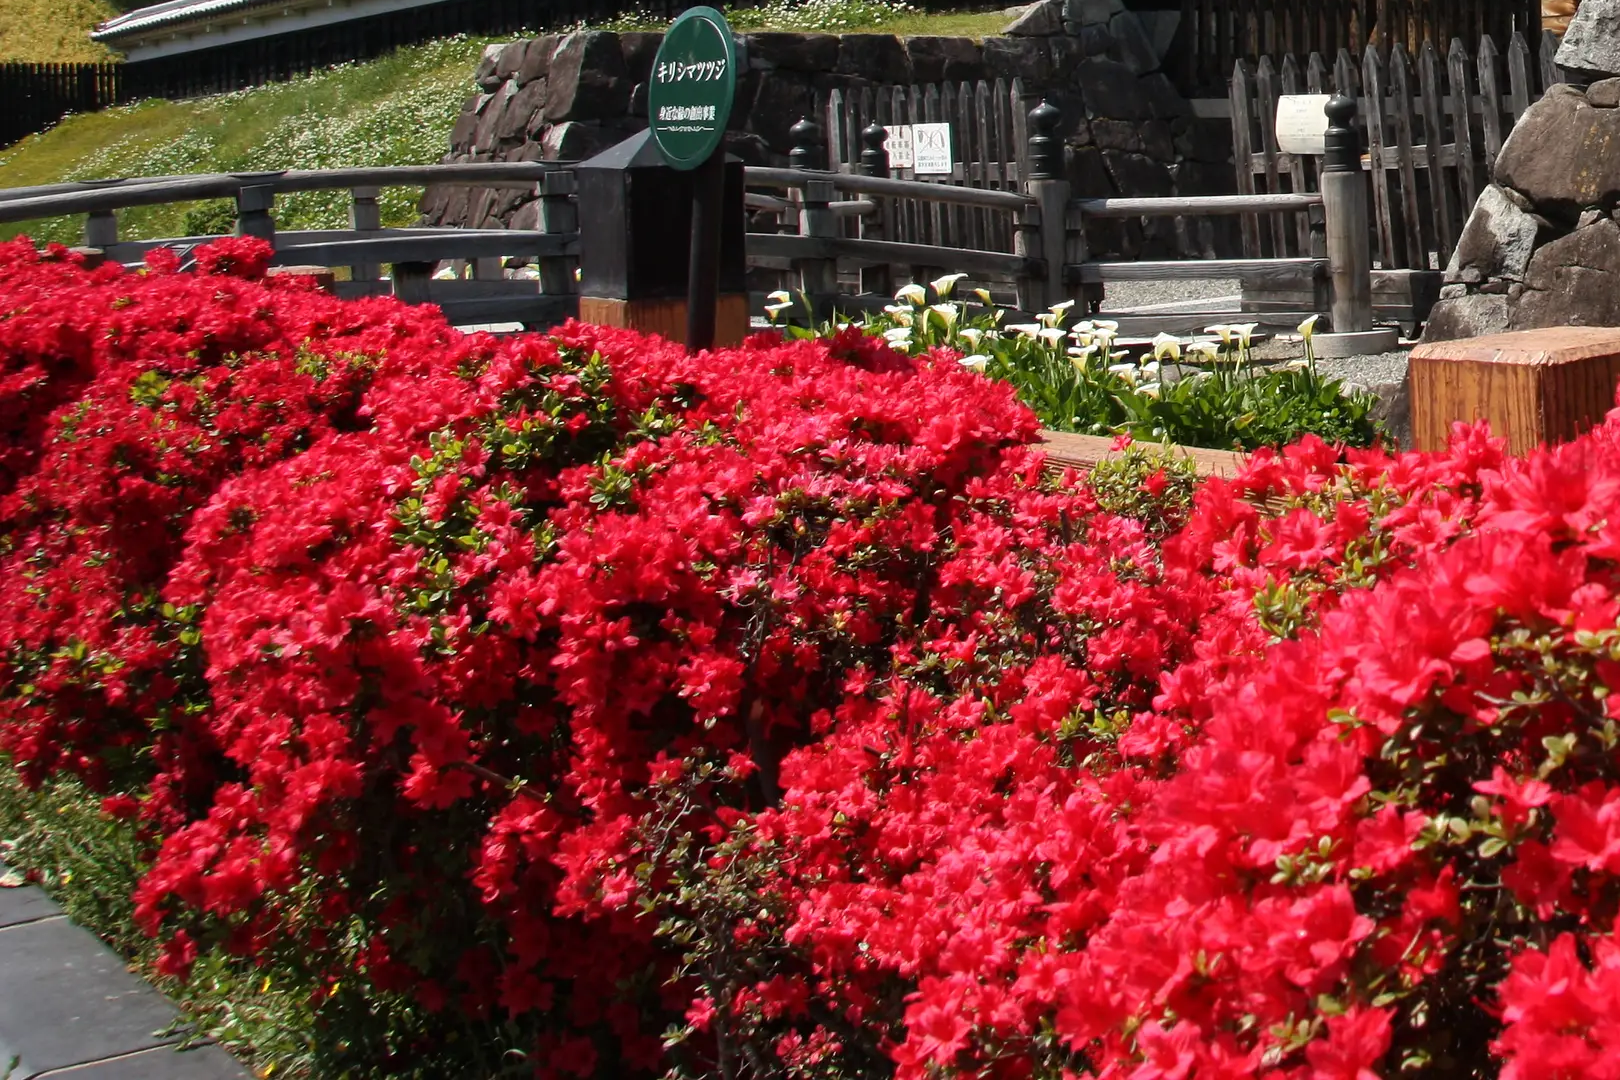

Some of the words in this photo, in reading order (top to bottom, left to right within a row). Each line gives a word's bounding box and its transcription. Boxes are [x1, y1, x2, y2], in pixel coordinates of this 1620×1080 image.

[657, 58, 726, 83] キリシマツツジ
